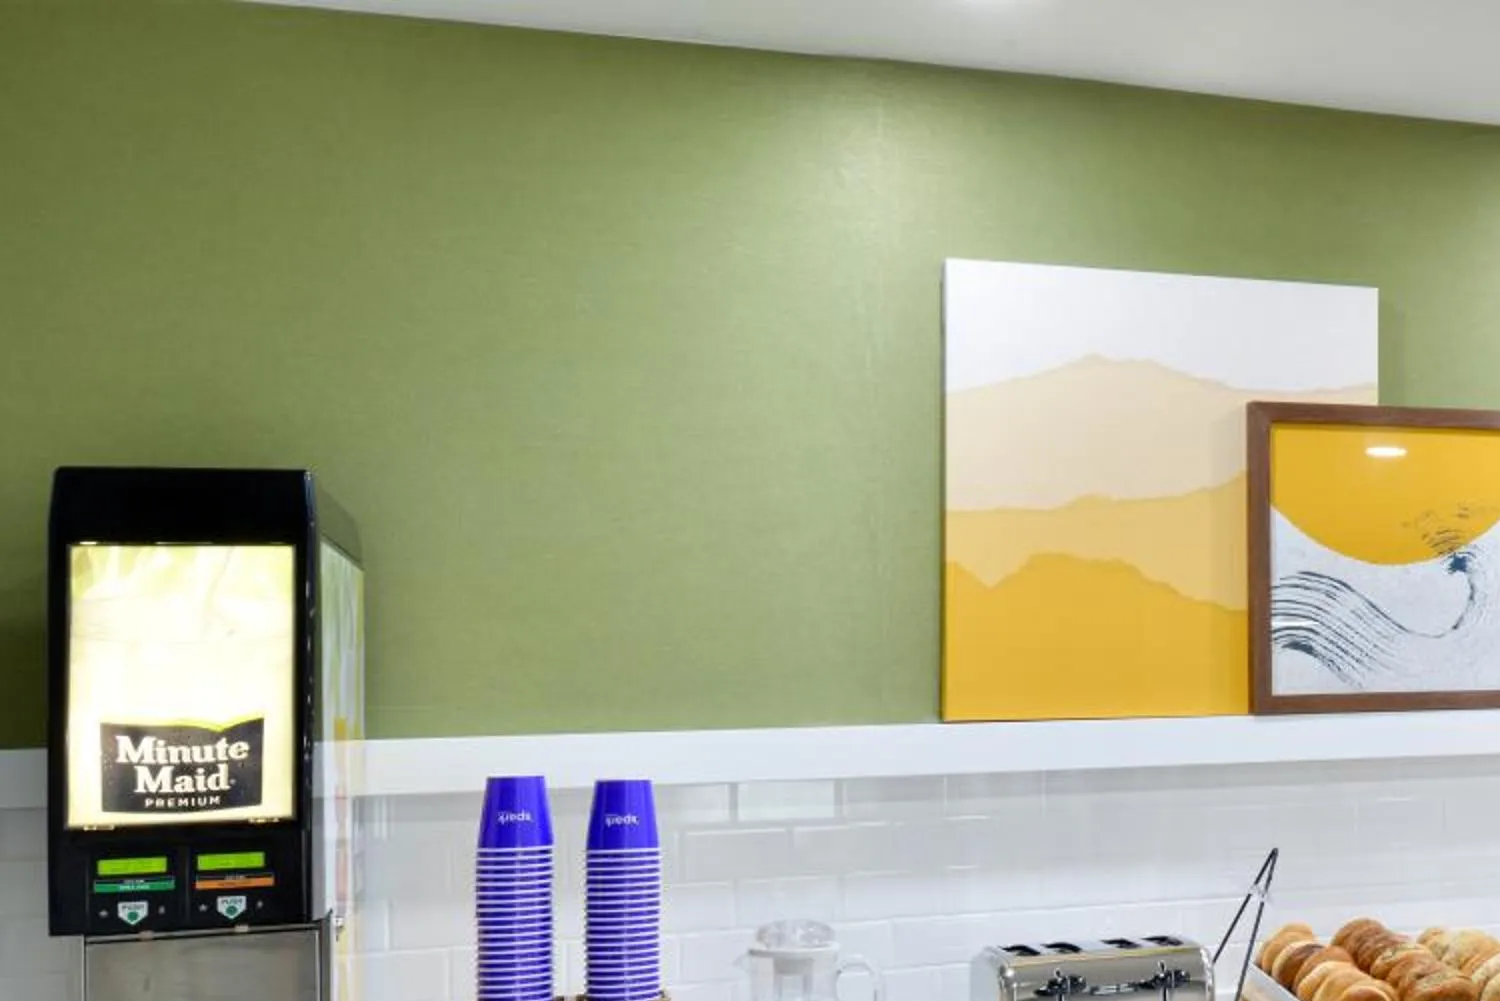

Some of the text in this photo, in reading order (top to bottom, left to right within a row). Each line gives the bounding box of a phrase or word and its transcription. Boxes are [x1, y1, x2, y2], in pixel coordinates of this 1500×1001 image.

[115, 735, 250, 765] Minute
[133, 763, 231, 793] Maid
[144, 796, 221, 808] PREMIUM
